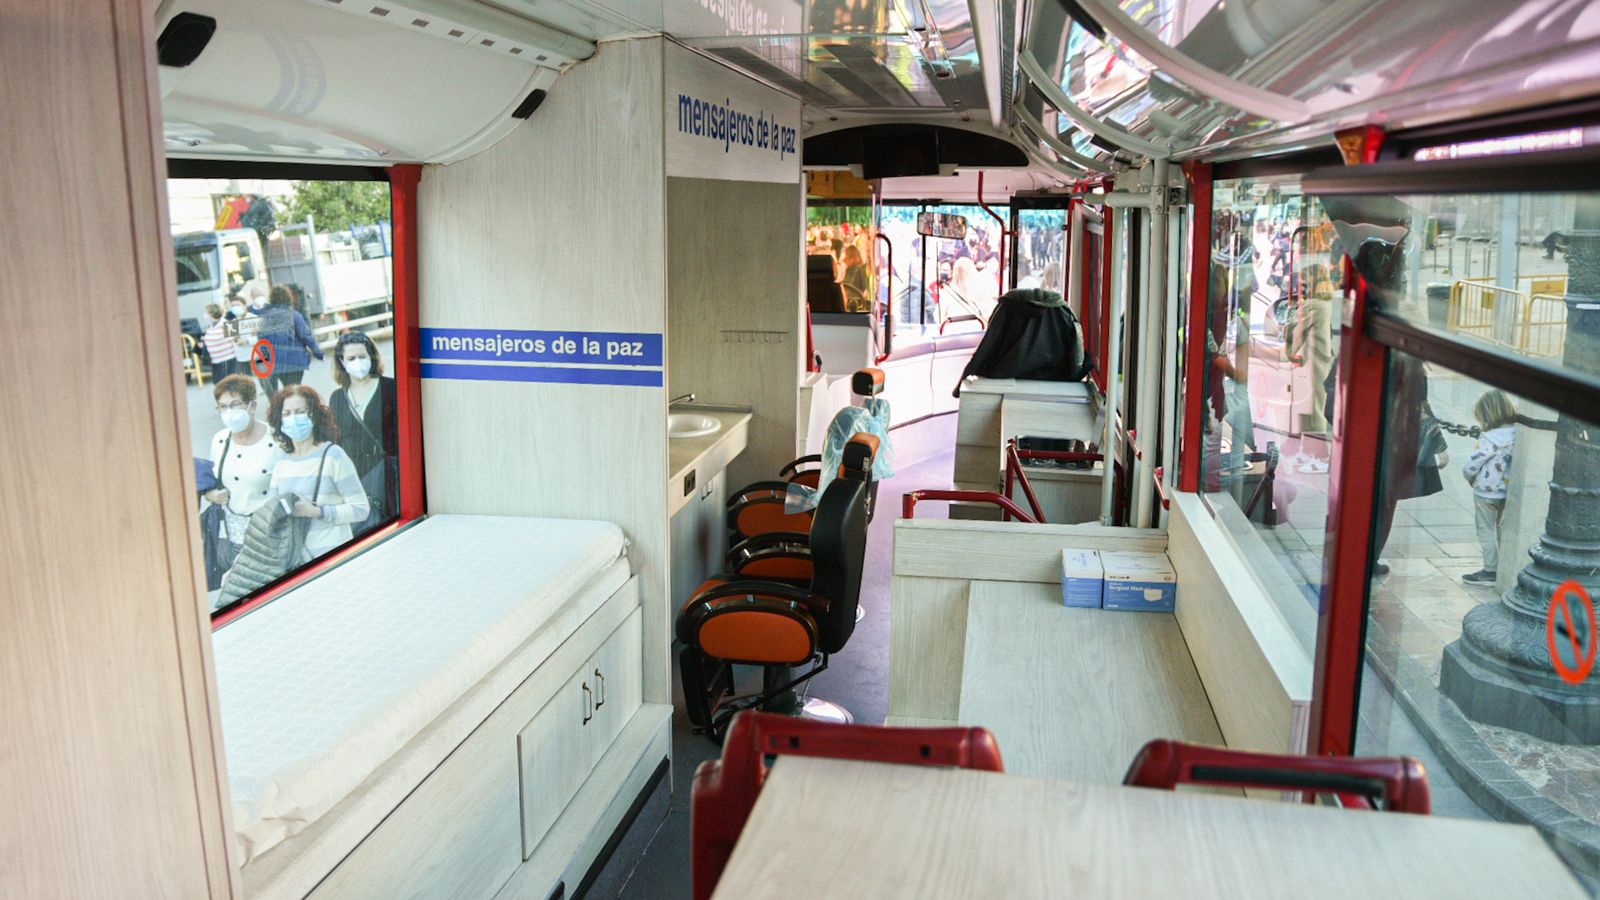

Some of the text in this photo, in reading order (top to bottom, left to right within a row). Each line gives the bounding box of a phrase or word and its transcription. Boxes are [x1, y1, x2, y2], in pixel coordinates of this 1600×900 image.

[678, 94, 796, 161] mensajeros de la paz
[432, 334, 643, 360] mensajeros de la paz
